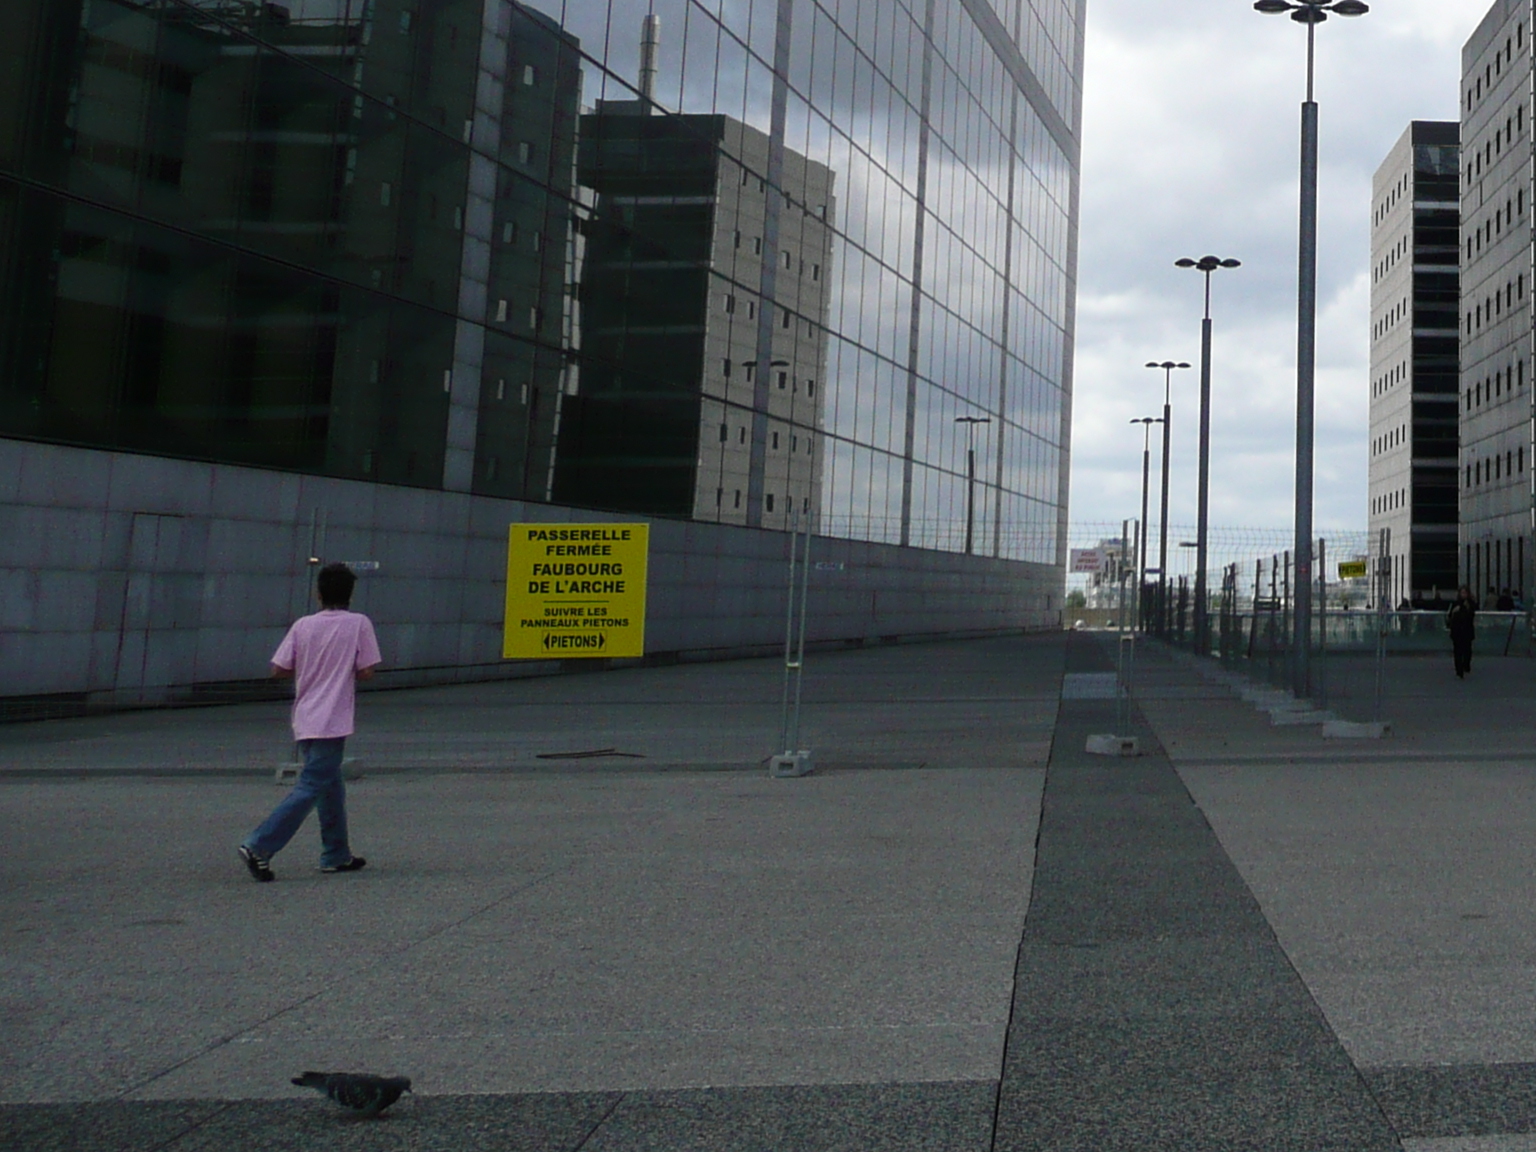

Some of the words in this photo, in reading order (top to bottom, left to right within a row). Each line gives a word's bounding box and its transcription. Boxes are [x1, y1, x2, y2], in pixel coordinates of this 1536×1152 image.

[528, 530, 631, 541] PASSERELLE
[546, 542, 612, 556] FERMÉE
[533, 563, 622, 576] FAUBOURG
[528, 581, 550, 593] DE
[555, 580, 625, 593] L'ARCHE
[544, 607, 584, 616] SUIVRE
[587, 607, 607, 616] LES
[520, 618, 579, 627] PANNEAUX
[582, 617, 629, 627] PIETONS
[551, 634, 597, 648] PIETONS
